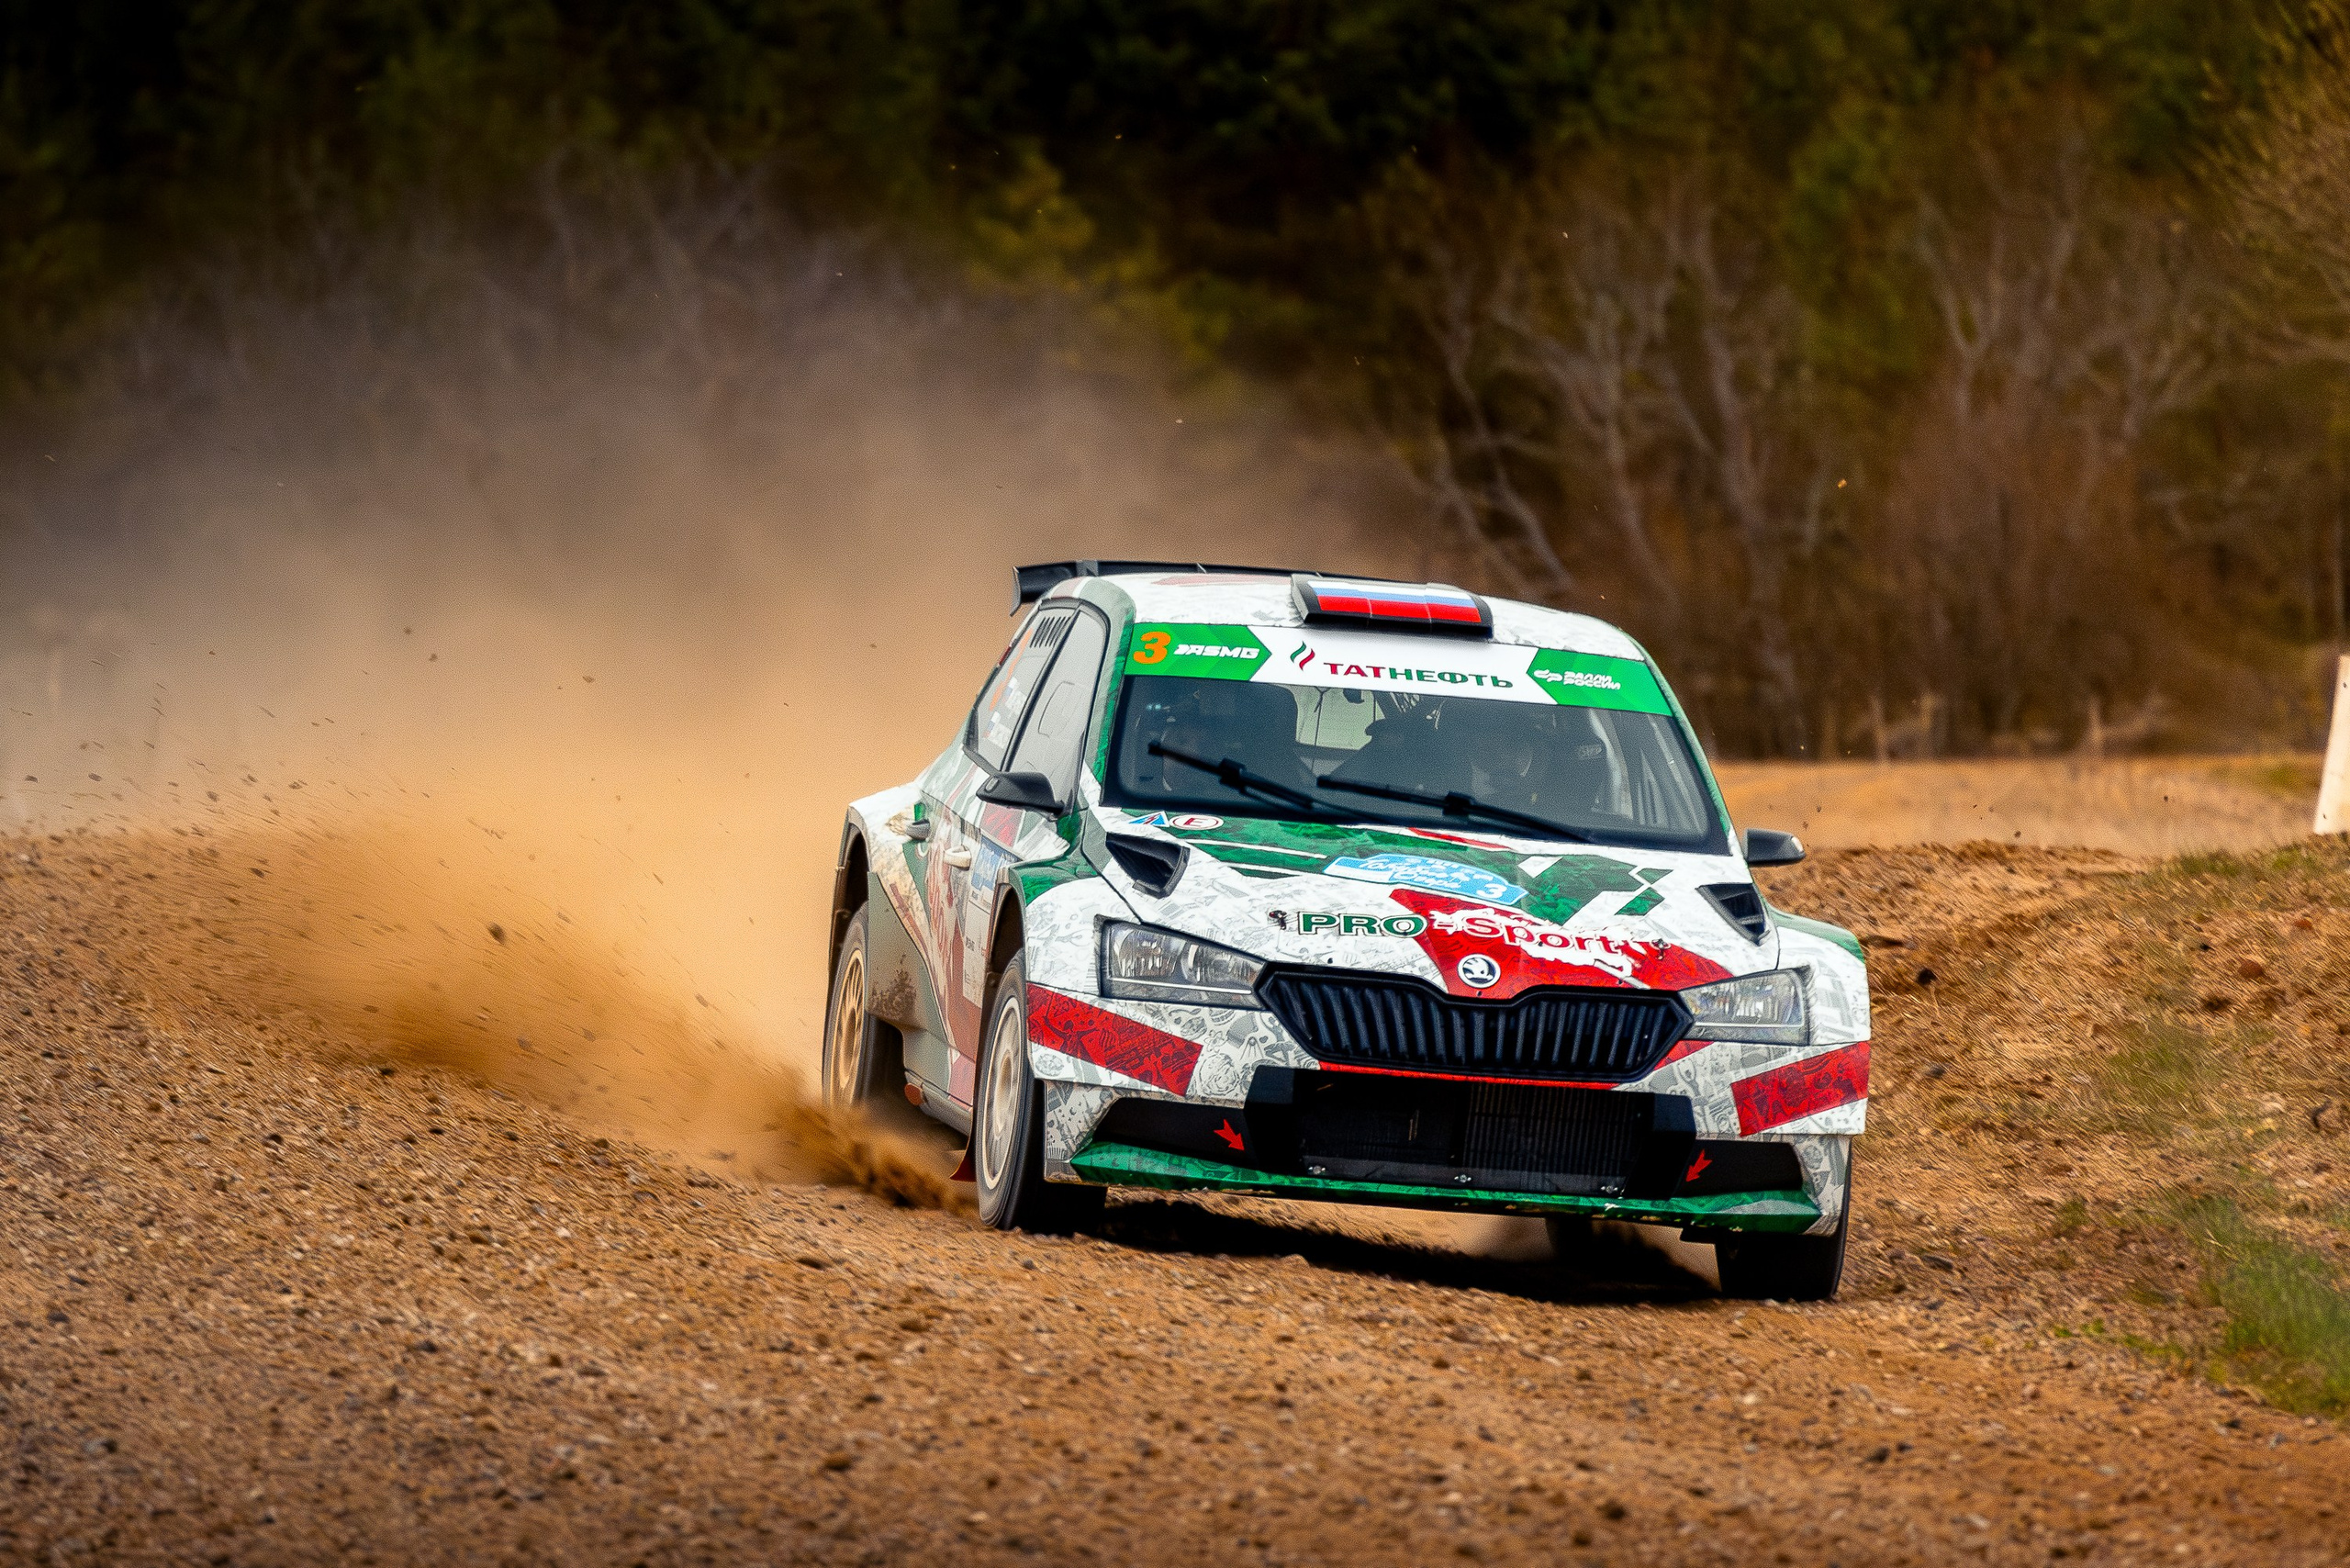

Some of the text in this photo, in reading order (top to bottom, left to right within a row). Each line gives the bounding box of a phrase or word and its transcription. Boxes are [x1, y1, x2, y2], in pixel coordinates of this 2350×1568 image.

[1133, 631, 1171, 665] 3
[1323, 662, 1514, 689] ТАТНЕФТЬ
[1182, 817, 1208, 827] E
[1475, 883, 1507, 899] 3
